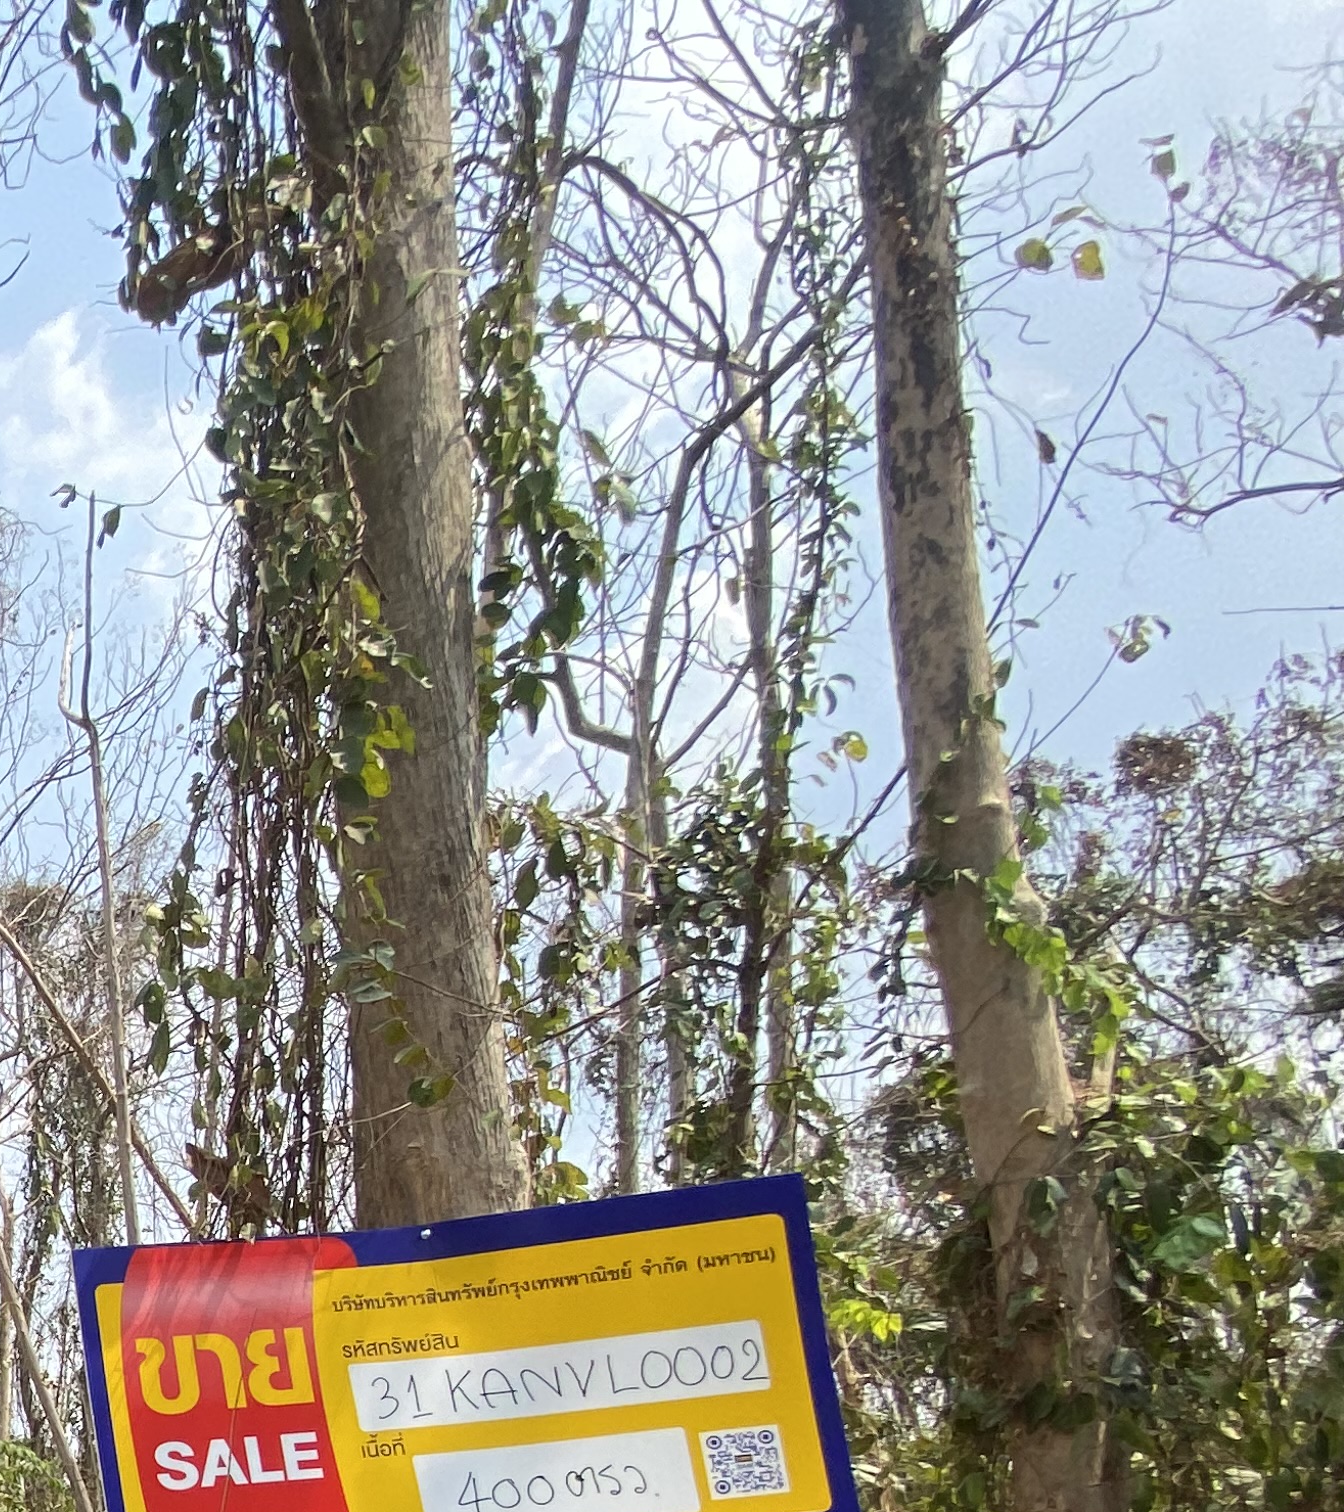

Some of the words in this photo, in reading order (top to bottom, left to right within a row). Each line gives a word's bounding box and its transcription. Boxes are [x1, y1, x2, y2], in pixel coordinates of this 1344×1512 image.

[640, 1255, 688, 1277] จำกัด
[697, 1246, 776, 1273] (มหาชน)
[342, 1333, 460, 1360] รหัสทรัพย์สิน
[135, 1327, 315, 1415] ขาย
[361, 1431, 407, 1459] เนื้อที่
[154, 1431, 324, 1491] SALE
